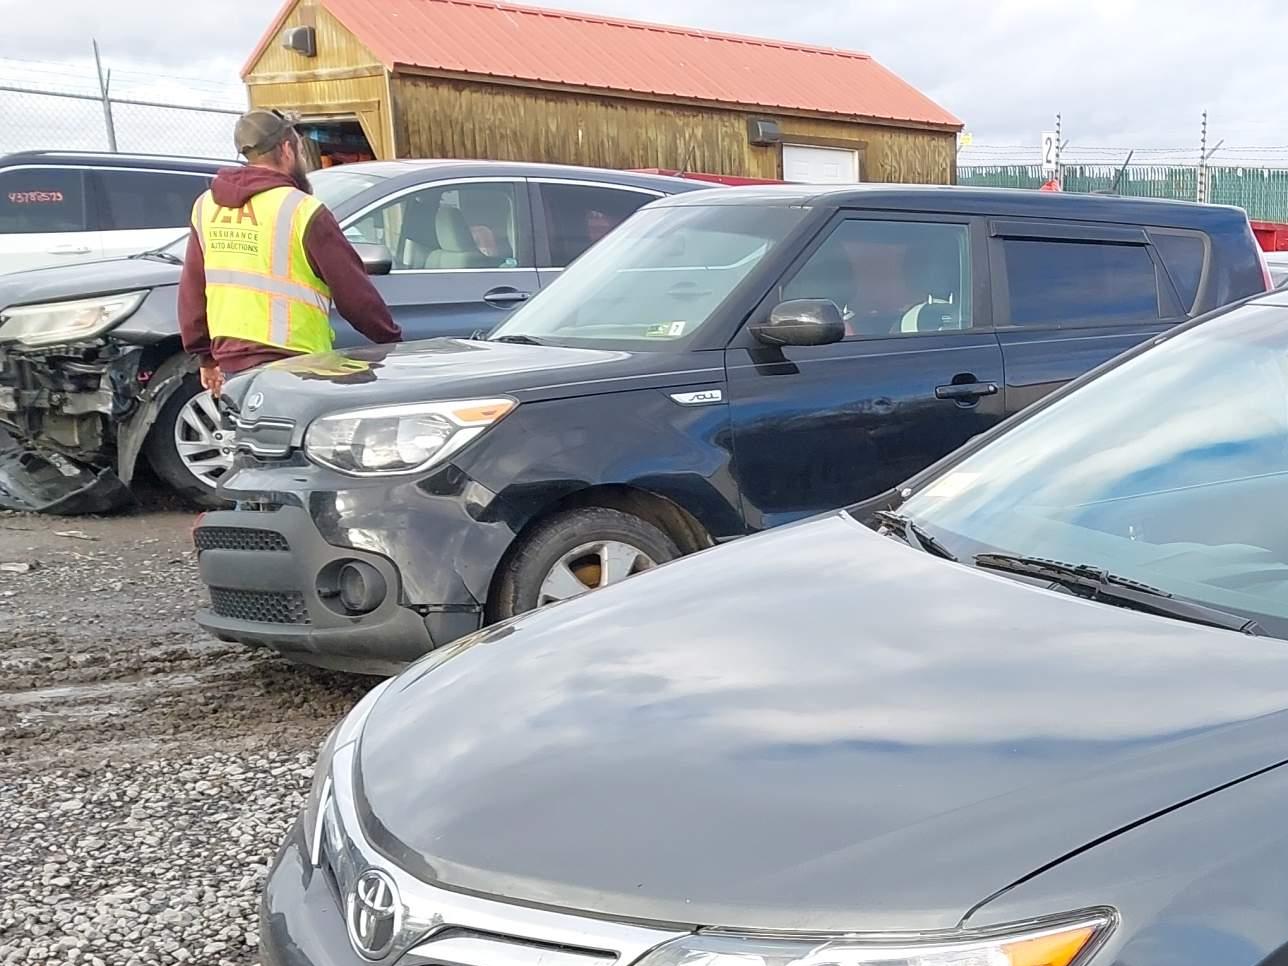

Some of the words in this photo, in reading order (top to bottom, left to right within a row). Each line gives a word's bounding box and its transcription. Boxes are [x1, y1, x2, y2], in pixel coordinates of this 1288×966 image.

[1045, 136, 1053, 164] 2
[209, 230, 259, 241] INSURANCE
[210, 241, 226, 250] AUTO
[226, 241, 259, 253] AUCTIONS
